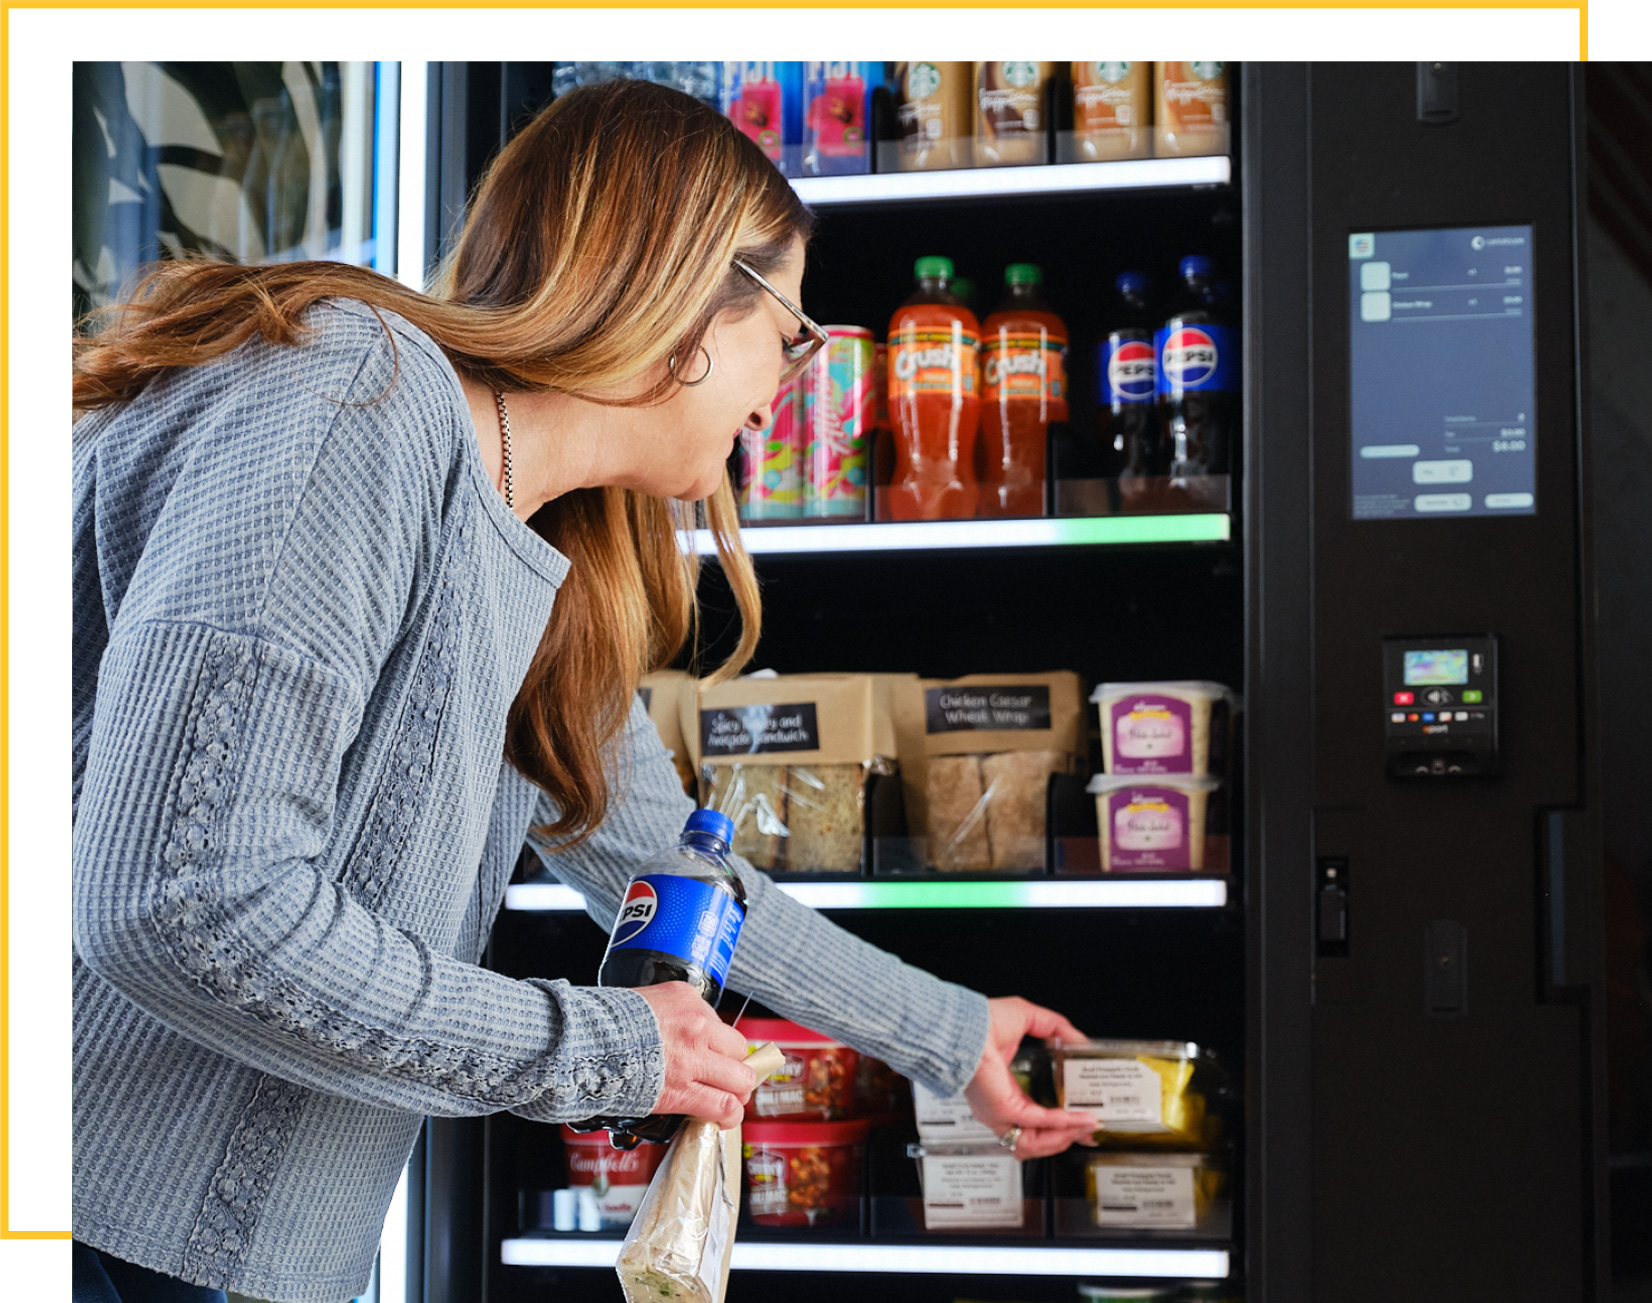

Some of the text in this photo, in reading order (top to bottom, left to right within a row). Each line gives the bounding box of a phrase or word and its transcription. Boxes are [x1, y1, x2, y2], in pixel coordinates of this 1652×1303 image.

[895, 343, 959, 380] Crush
[1164, 350, 1213, 363] PEPSI
[985, 349, 1046, 385] Crush
[1116, 363, 1154, 376] PEPS
[940, 692, 988, 709] Chicken
[779, 713, 803, 730] and
[992, 709, 1030, 726] Wrap
[621, 903, 654, 921] PSI
[569, 1151, 639, 1176] Campbell's
